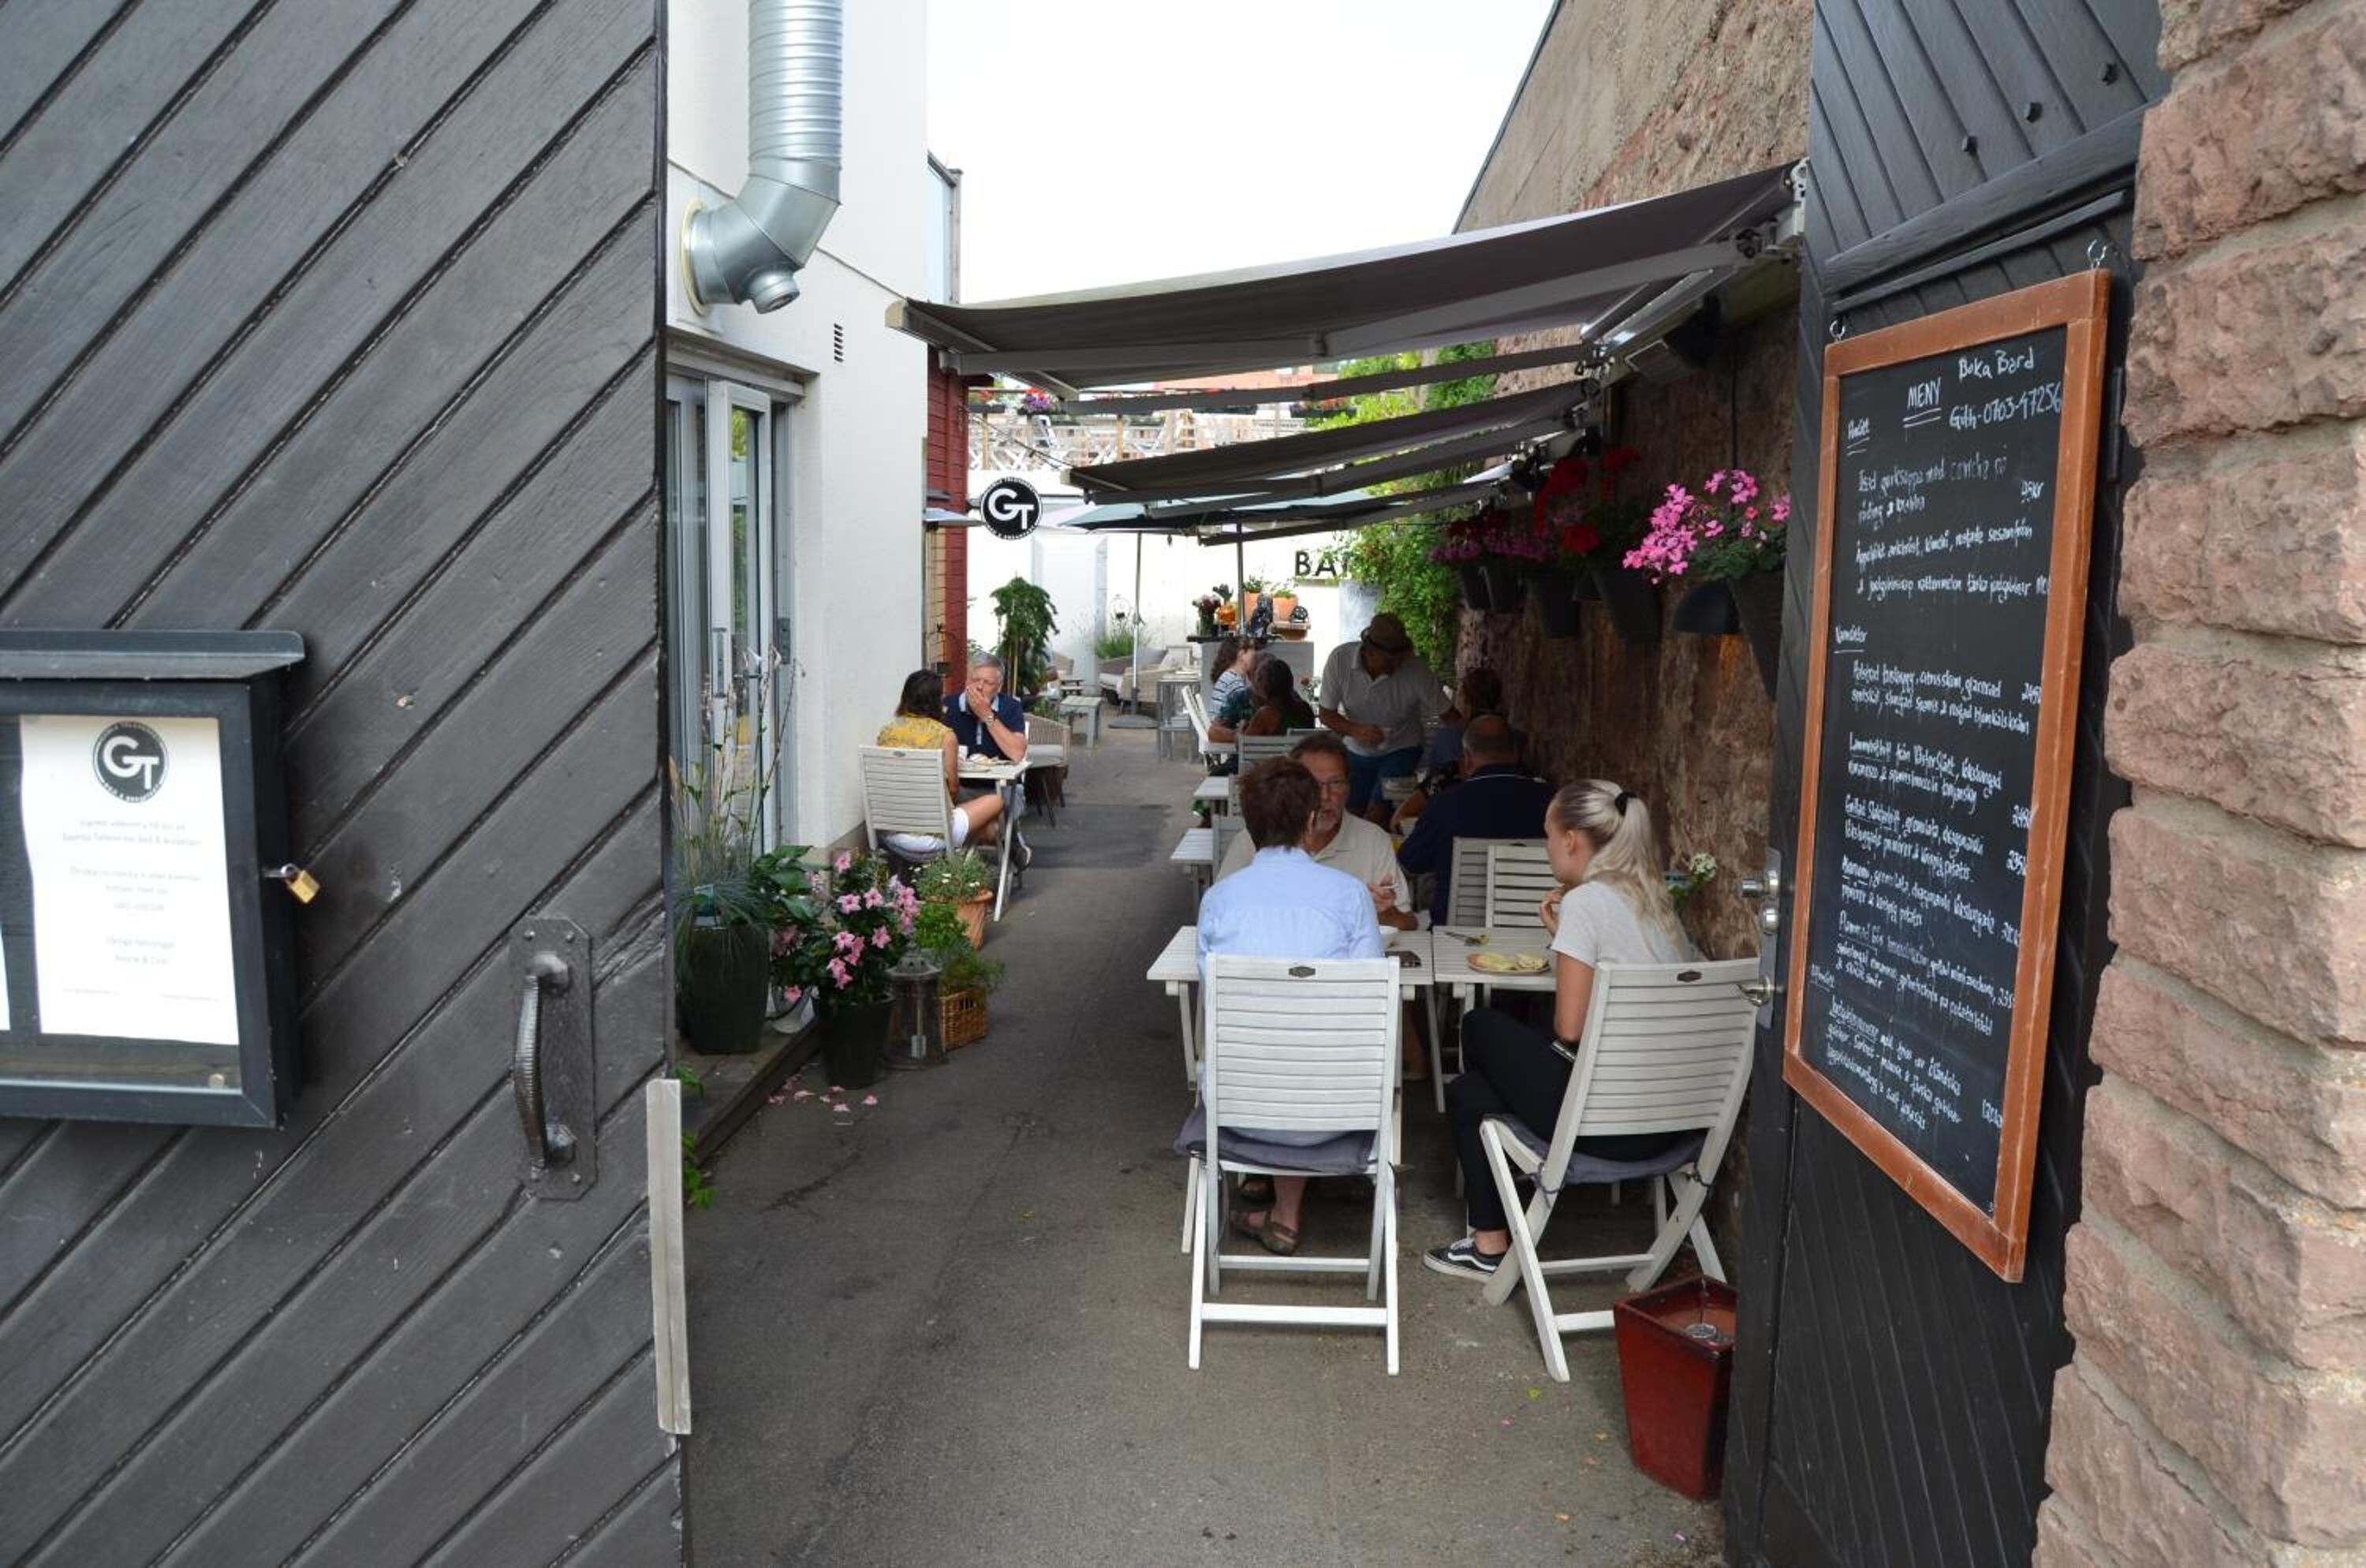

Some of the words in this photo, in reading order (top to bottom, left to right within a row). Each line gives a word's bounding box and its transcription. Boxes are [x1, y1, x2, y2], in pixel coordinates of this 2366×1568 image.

[1958, 357, 1992, 382] Boka
[1907, 376, 1941, 409] MENY
[988, 487, 1034, 529] GT
[103, 735, 159, 790] GT
